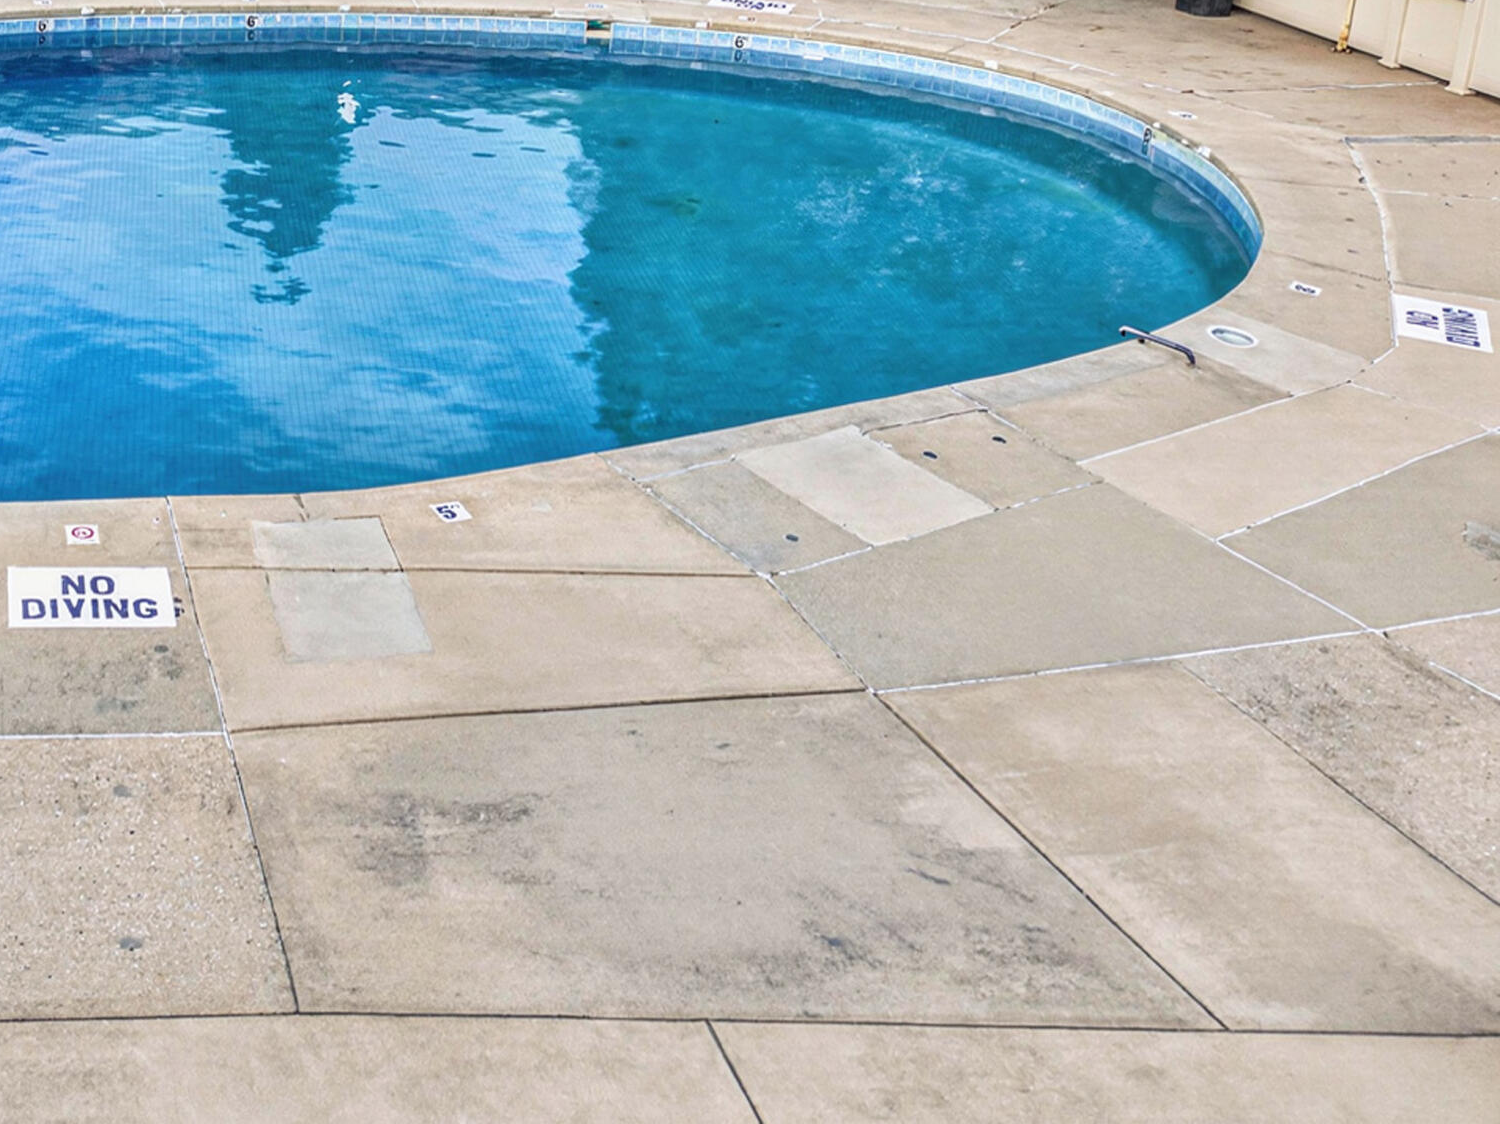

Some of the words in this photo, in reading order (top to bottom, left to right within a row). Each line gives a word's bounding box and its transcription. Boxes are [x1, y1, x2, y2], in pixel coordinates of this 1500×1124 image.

[1406, 310, 1439, 330] NO
[1442, 307, 1480, 347] DIVING
[61, 574, 115, 595] NO
[21, 598, 158, 619] DIVING
